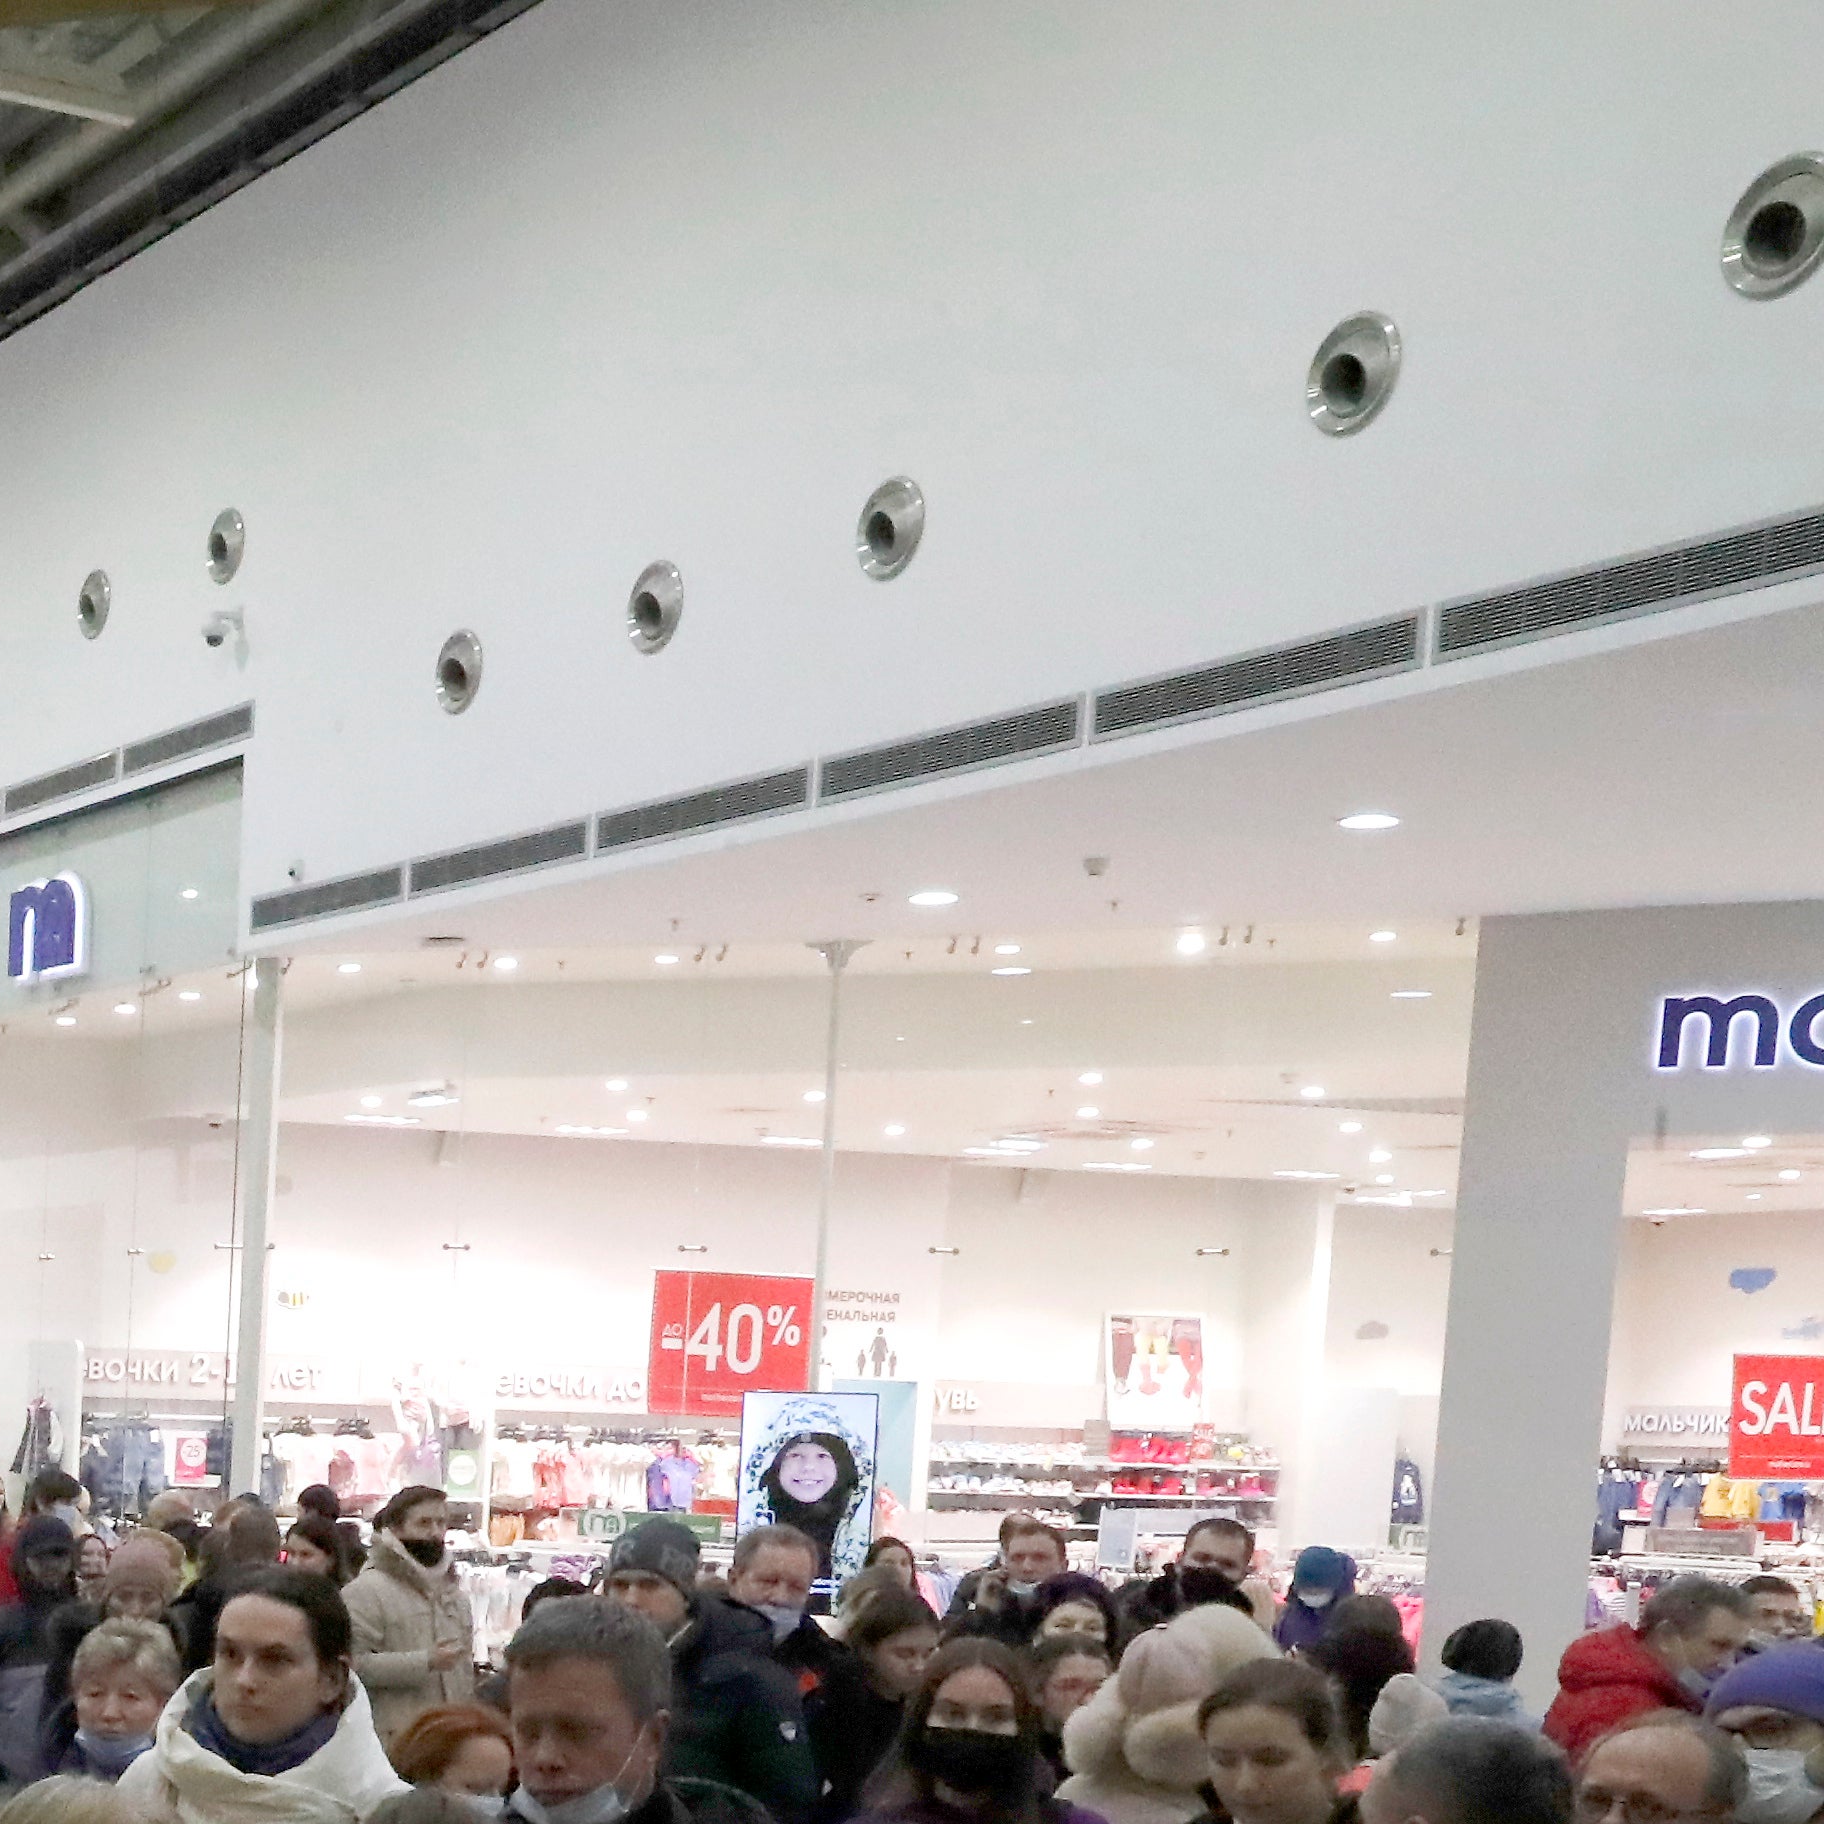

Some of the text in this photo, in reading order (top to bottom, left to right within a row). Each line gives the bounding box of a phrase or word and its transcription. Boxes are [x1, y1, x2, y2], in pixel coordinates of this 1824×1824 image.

[8, 874, 82, 977] m
[83, 1357, 180, 1384] вочки
[1739, 1380, 1824, 1436] SAL
